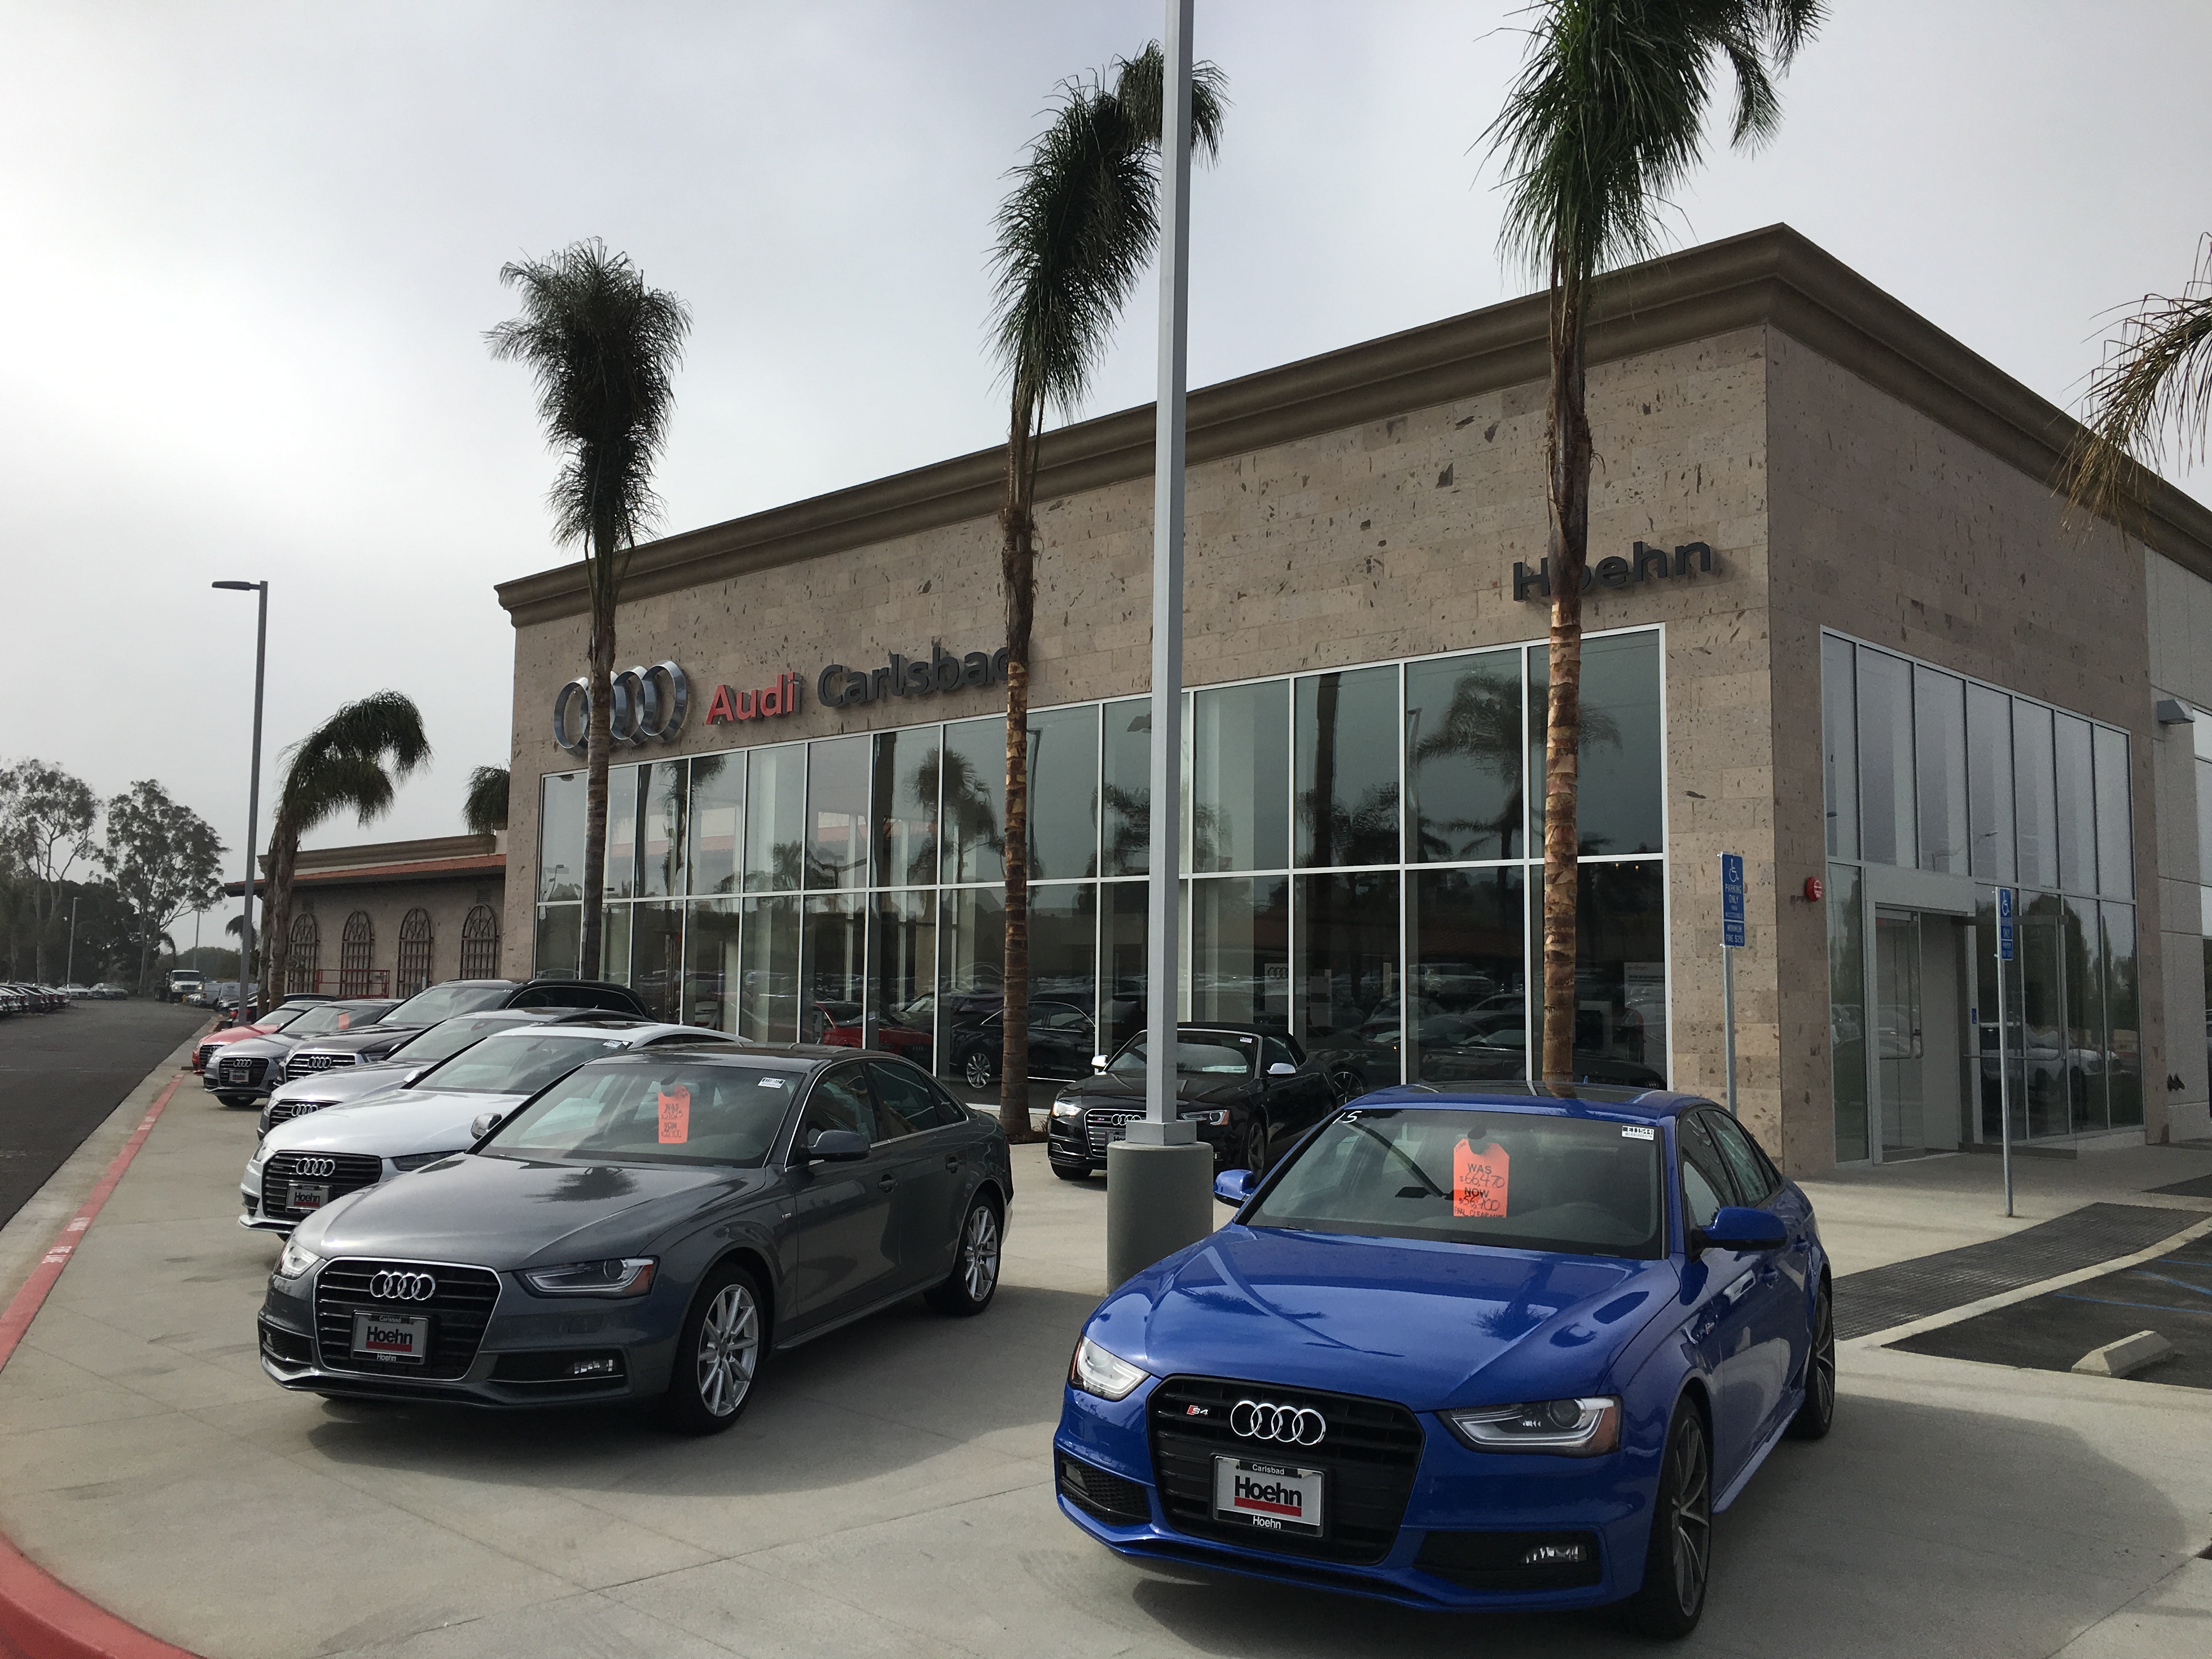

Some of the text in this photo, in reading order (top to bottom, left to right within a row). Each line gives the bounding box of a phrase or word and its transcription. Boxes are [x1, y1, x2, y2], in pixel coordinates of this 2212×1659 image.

[1513, 540, 1711, 602] Hehn
[706, 672, 800, 725] Audi
[1725, 883, 1742, 894] PARKING
[1729, 894, 1739, 904] ONLY
[1332, 1110, 1363, 1125] 15
[1468, 1163, 1492, 1174] WAS
[1459, 1172, 1505, 1188] $66,470
[294, 1192, 320, 1203] Hoehn
[1464, 1187, 1489, 1198] NOW
[366, 1325, 413, 1345] Hoehn
[376, 1353, 397, 1362] Hoehn
[1189, 1406, 1209, 1416] S4
[1252, 1464, 1285, 1475] Carlsbad
[1234, 1475, 1302, 1508] Hoehn
[1252, 1515, 1282, 1530] Hoehn
